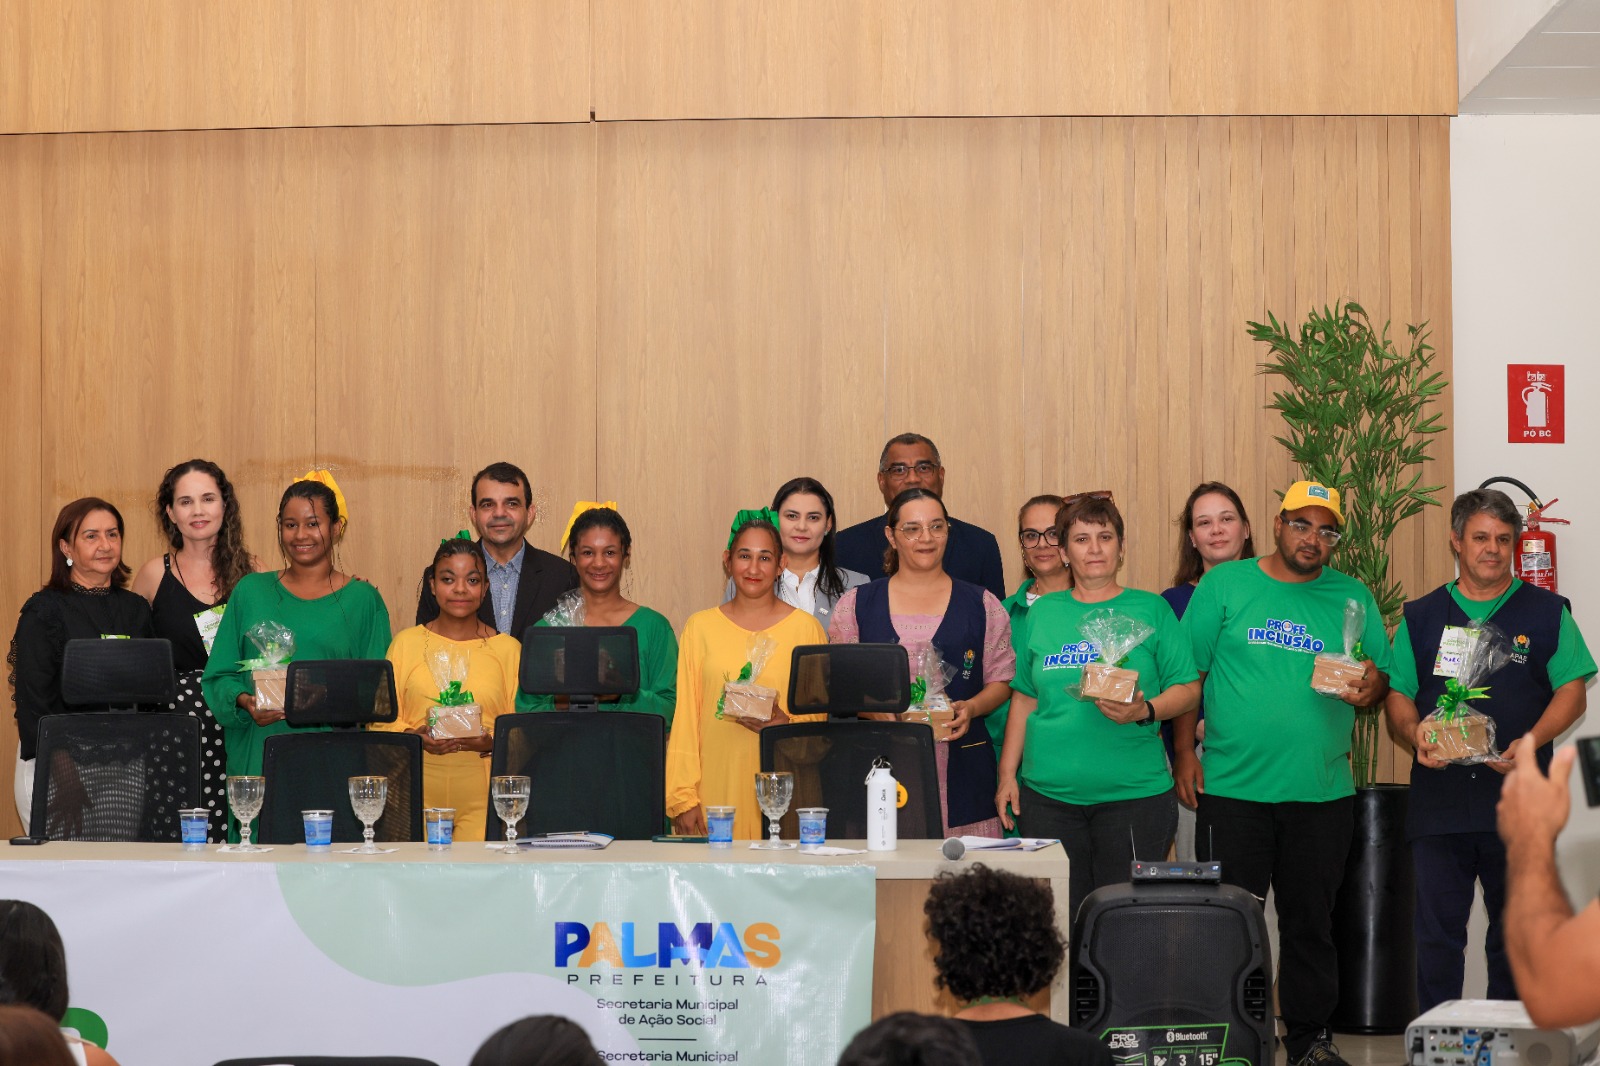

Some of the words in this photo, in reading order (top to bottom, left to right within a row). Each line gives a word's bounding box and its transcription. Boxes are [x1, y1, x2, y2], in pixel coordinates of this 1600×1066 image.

[1523, 429, 1536, 438] PÓ
[1539, 430, 1552, 438] BC
[1266, 618, 1306, 636] PROFE
[1061, 640, 1100, 653] PROF
[1248, 628, 1324, 653] INCLUSÃO
[554, 921, 782, 969] PALMAS
[567, 973, 768, 987] PREFEITURA
[596, 998, 673, 1010] Secretaria
[675, 998, 739, 1011] Municipal
[618, 1013, 636, 1025] de
[638, 1013, 674, 1028] Ação
[676, 1013, 717, 1026] Social
[1111, 1033, 1136, 1042] PRO
[1175, 1031, 1209, 1041] Bluetooth
[597, 1050, 673, 1062] Secretaria
[675, 1050, 739, 1063] Municipal
[1179, 1054, 1187, 1066] 3
